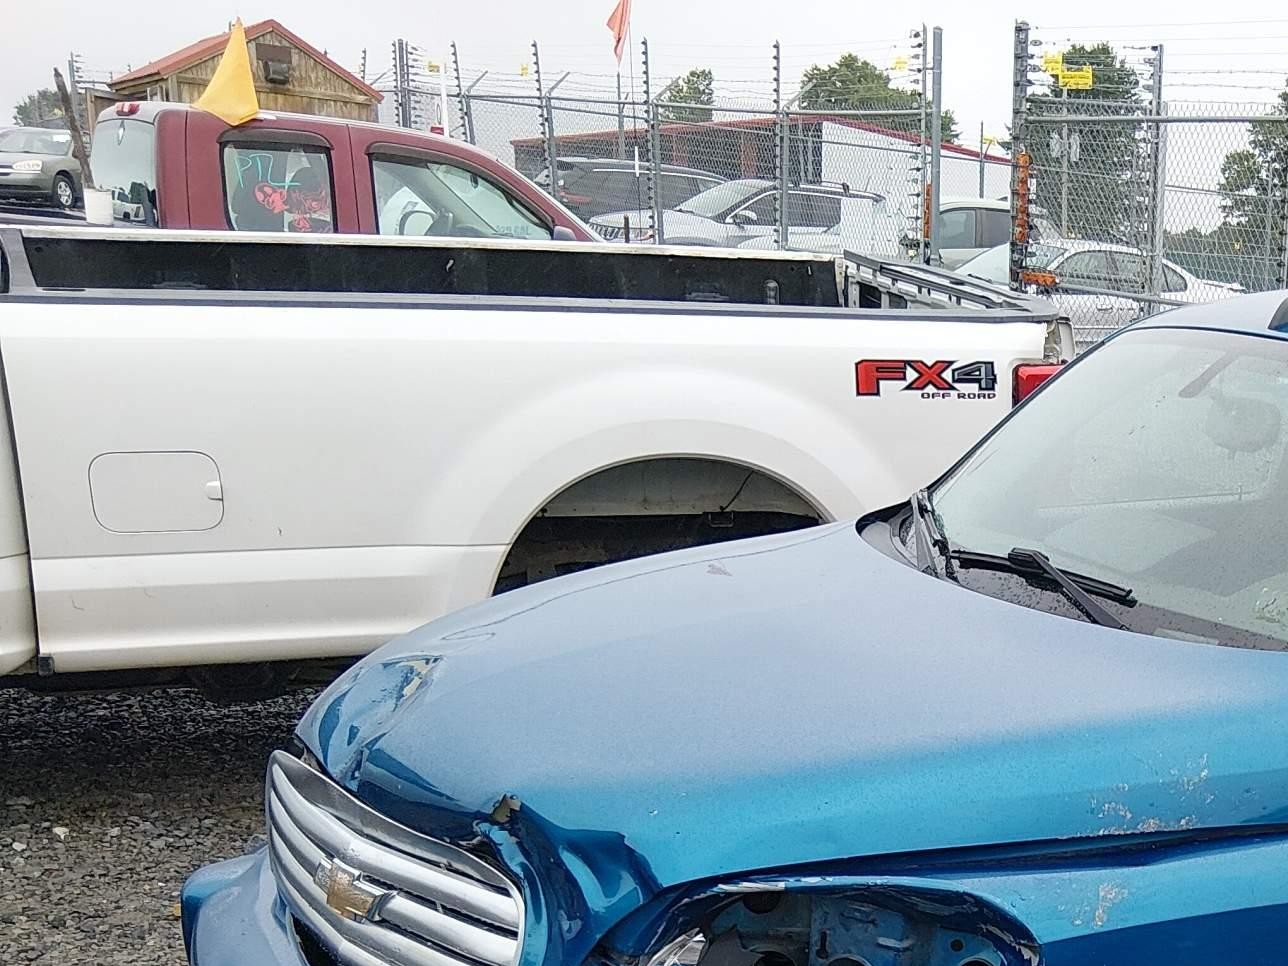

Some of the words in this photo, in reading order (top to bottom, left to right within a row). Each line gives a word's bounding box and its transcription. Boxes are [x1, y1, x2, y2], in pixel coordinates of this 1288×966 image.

[855, 359, 997, 397] FX4
[920, 392, 952, 400] OFF
[957, 392, 997, 400] ROAD
